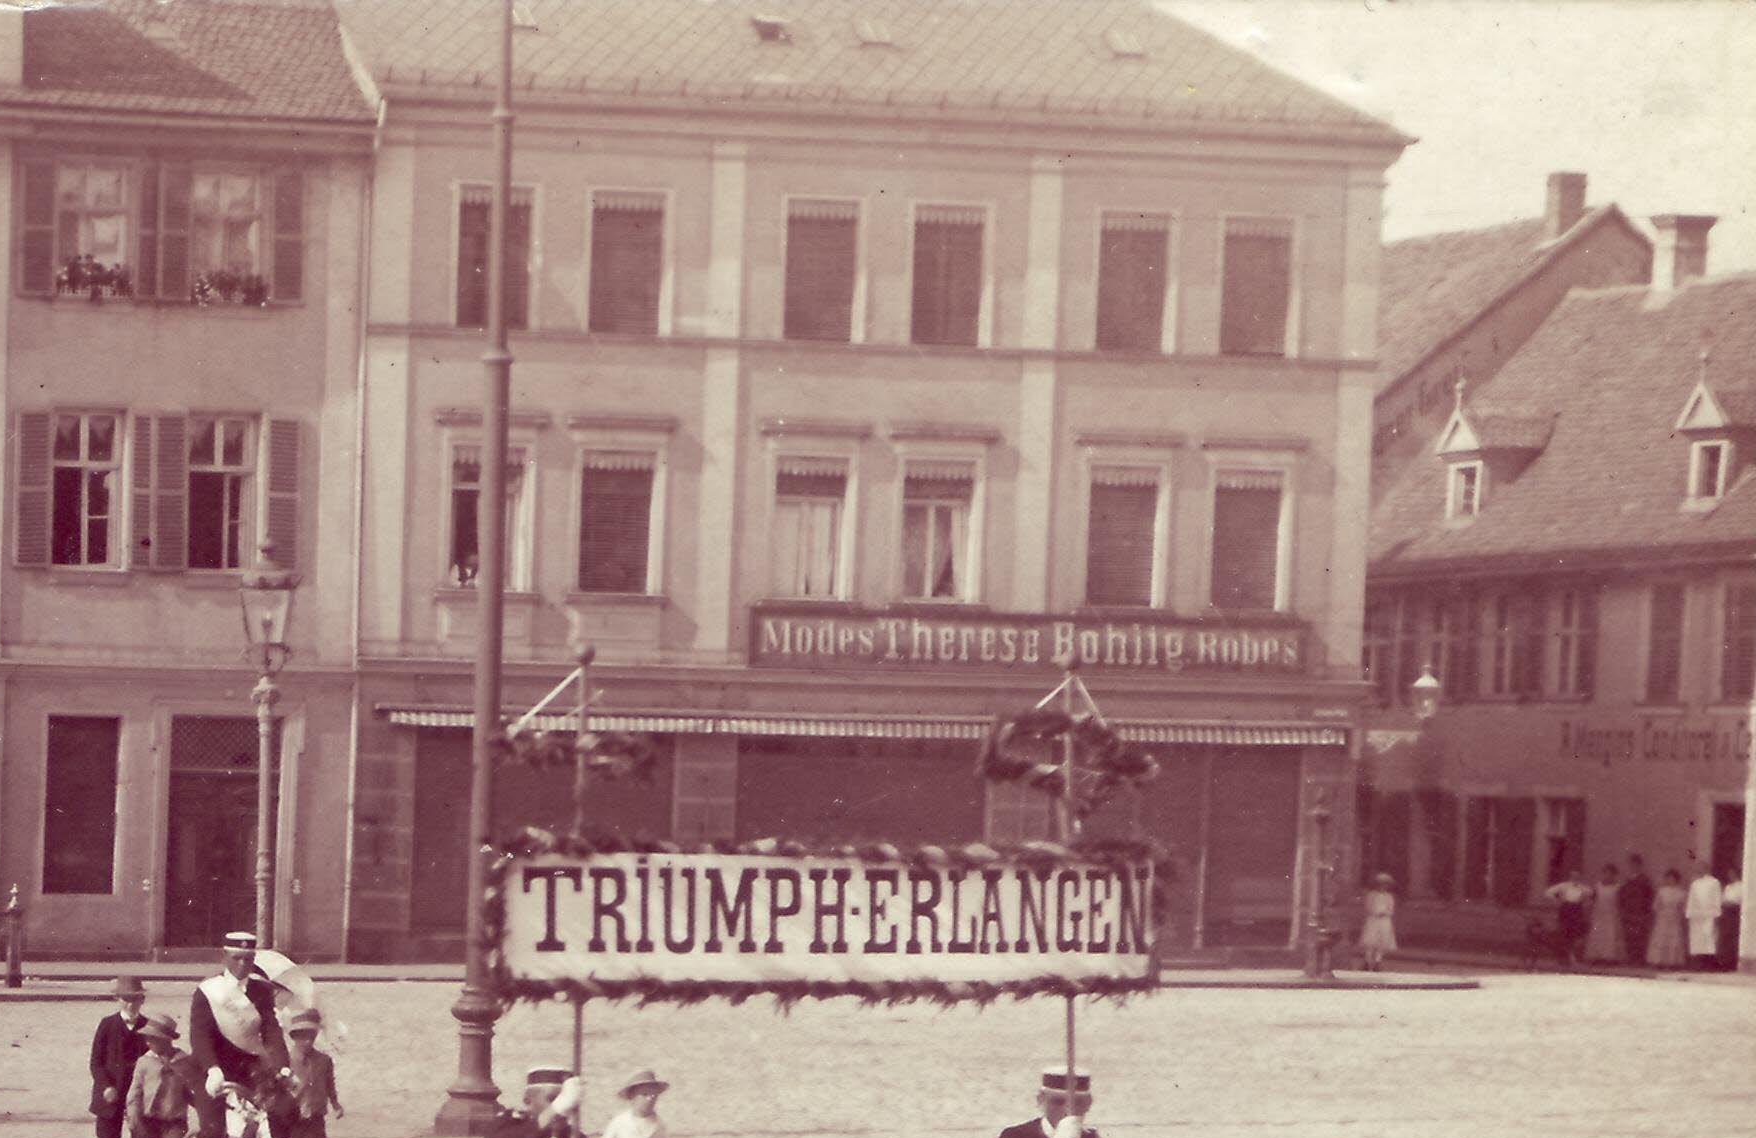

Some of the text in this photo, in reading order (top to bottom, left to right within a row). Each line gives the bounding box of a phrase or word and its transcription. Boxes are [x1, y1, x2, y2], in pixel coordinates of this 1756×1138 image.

[760, 618, 875, 656] Modes
[877, 617, 1040, 664] Therese
[1196, 630, 1300, 666] Robes
